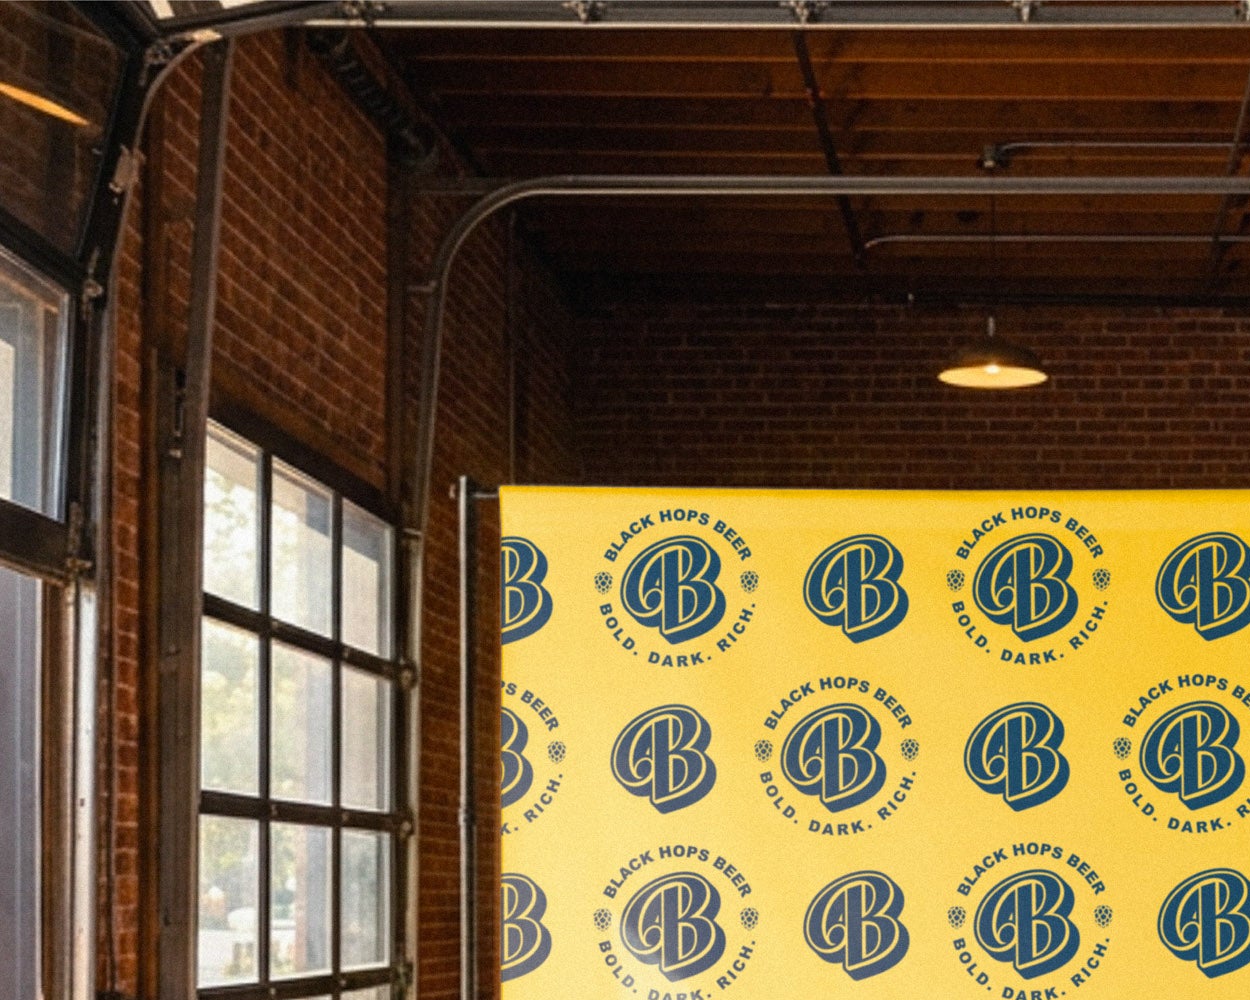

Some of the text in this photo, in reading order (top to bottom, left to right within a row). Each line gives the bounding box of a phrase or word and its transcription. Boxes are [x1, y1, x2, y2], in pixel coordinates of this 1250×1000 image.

[604, 509, 752, 562] BLACK HOPS BEER
[956, 506, 1104, 560] BLACK HOPS BEER
[600, 603, 755, 667] BOLD. DARK. RICH.
[952, 601, 1108, 665] BOLD. DARK. RICH.
[521, 690, 559, 731] BEER
[764, 676, 912, 730] BLACK HOPS BEER
[1123, 680, 1173, 727] BLACK
[1178, 674, 1228, 691] HOPS
[524, 774, 562, 822] RICH.
[760, 771, 916, 835] BOLD. DARK. RICH.
[1119, 769, 1157, 821] BOLD.
[1168, 817, 1231, 833] DARK.
[603, 845, 751, 899] BLACK HOPS BEER
[957, 842, 1105, 896] BLACK HOPS BEER
[599, 941, 636, 992] BOLD.
[716, 941, 755, 990] RICH.
[953, 938, 991, 991] BOLD.
[1071, 938, 1110, 987] RICH.
